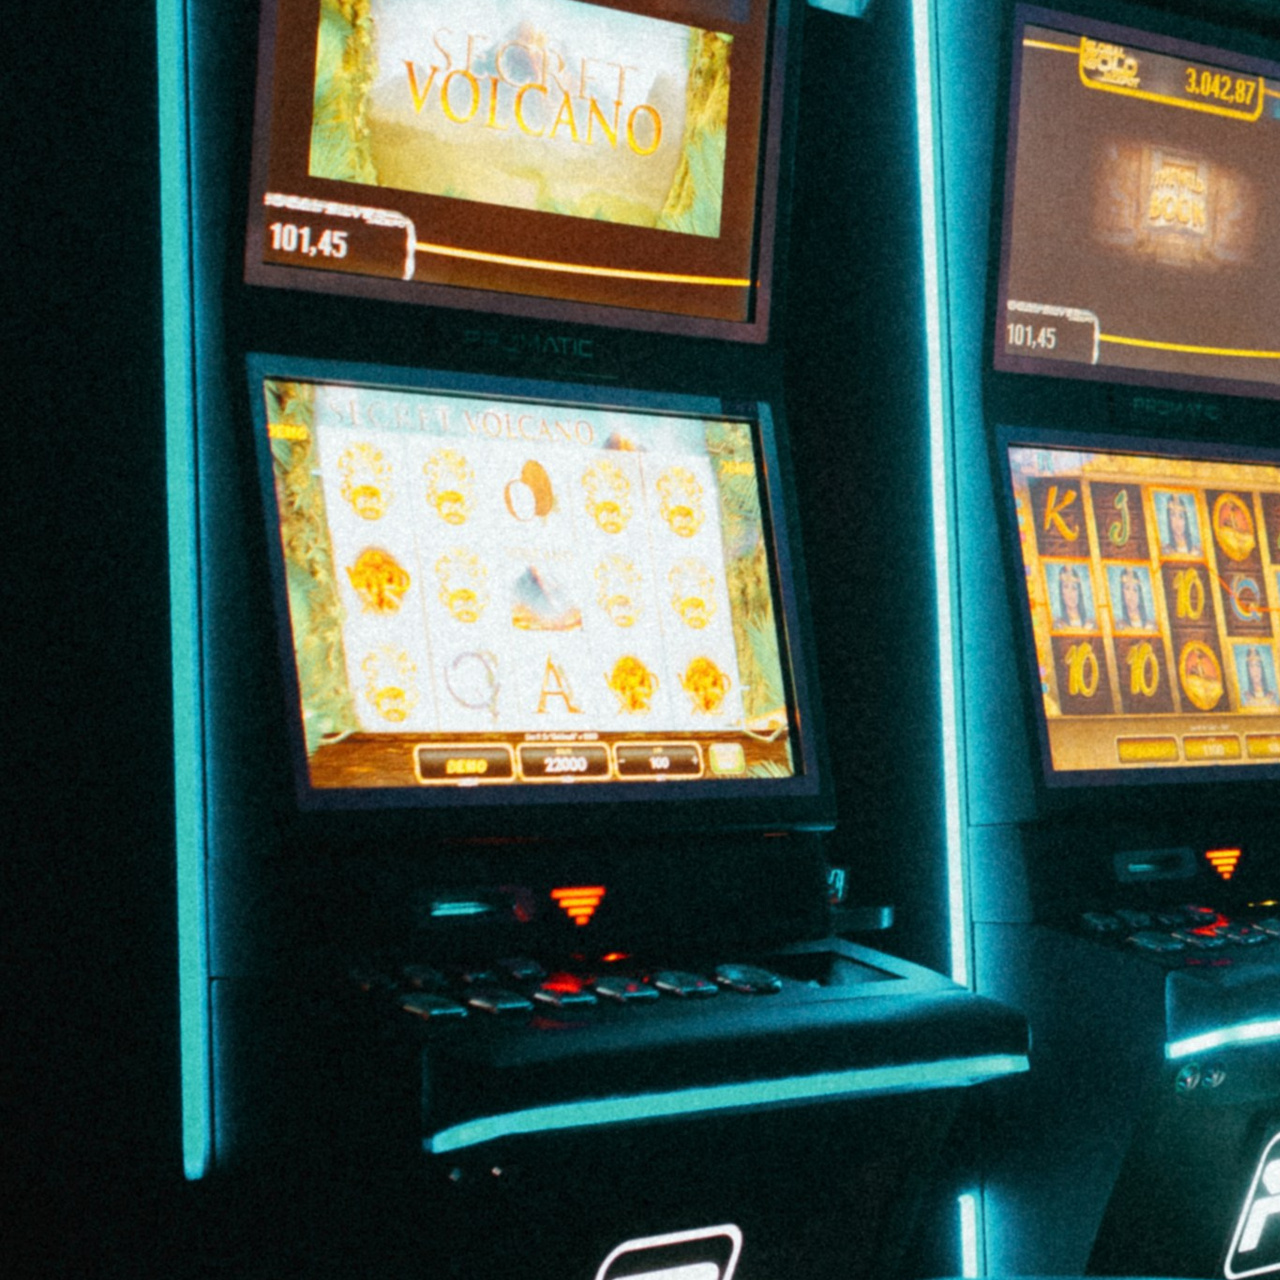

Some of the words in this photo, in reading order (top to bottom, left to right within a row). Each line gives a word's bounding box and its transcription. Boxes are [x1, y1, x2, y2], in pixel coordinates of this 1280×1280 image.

[432, 27, 640, 105] SECRET
[1185, 68, 1256, 106] 3.042,87
[403, 60, 662, 156] VOLCANO
[269, 222, 348, 260] 101,45
[1007, 323, 1056, 350] 101,45
[462, 409, 596, 446] VOLCANO
